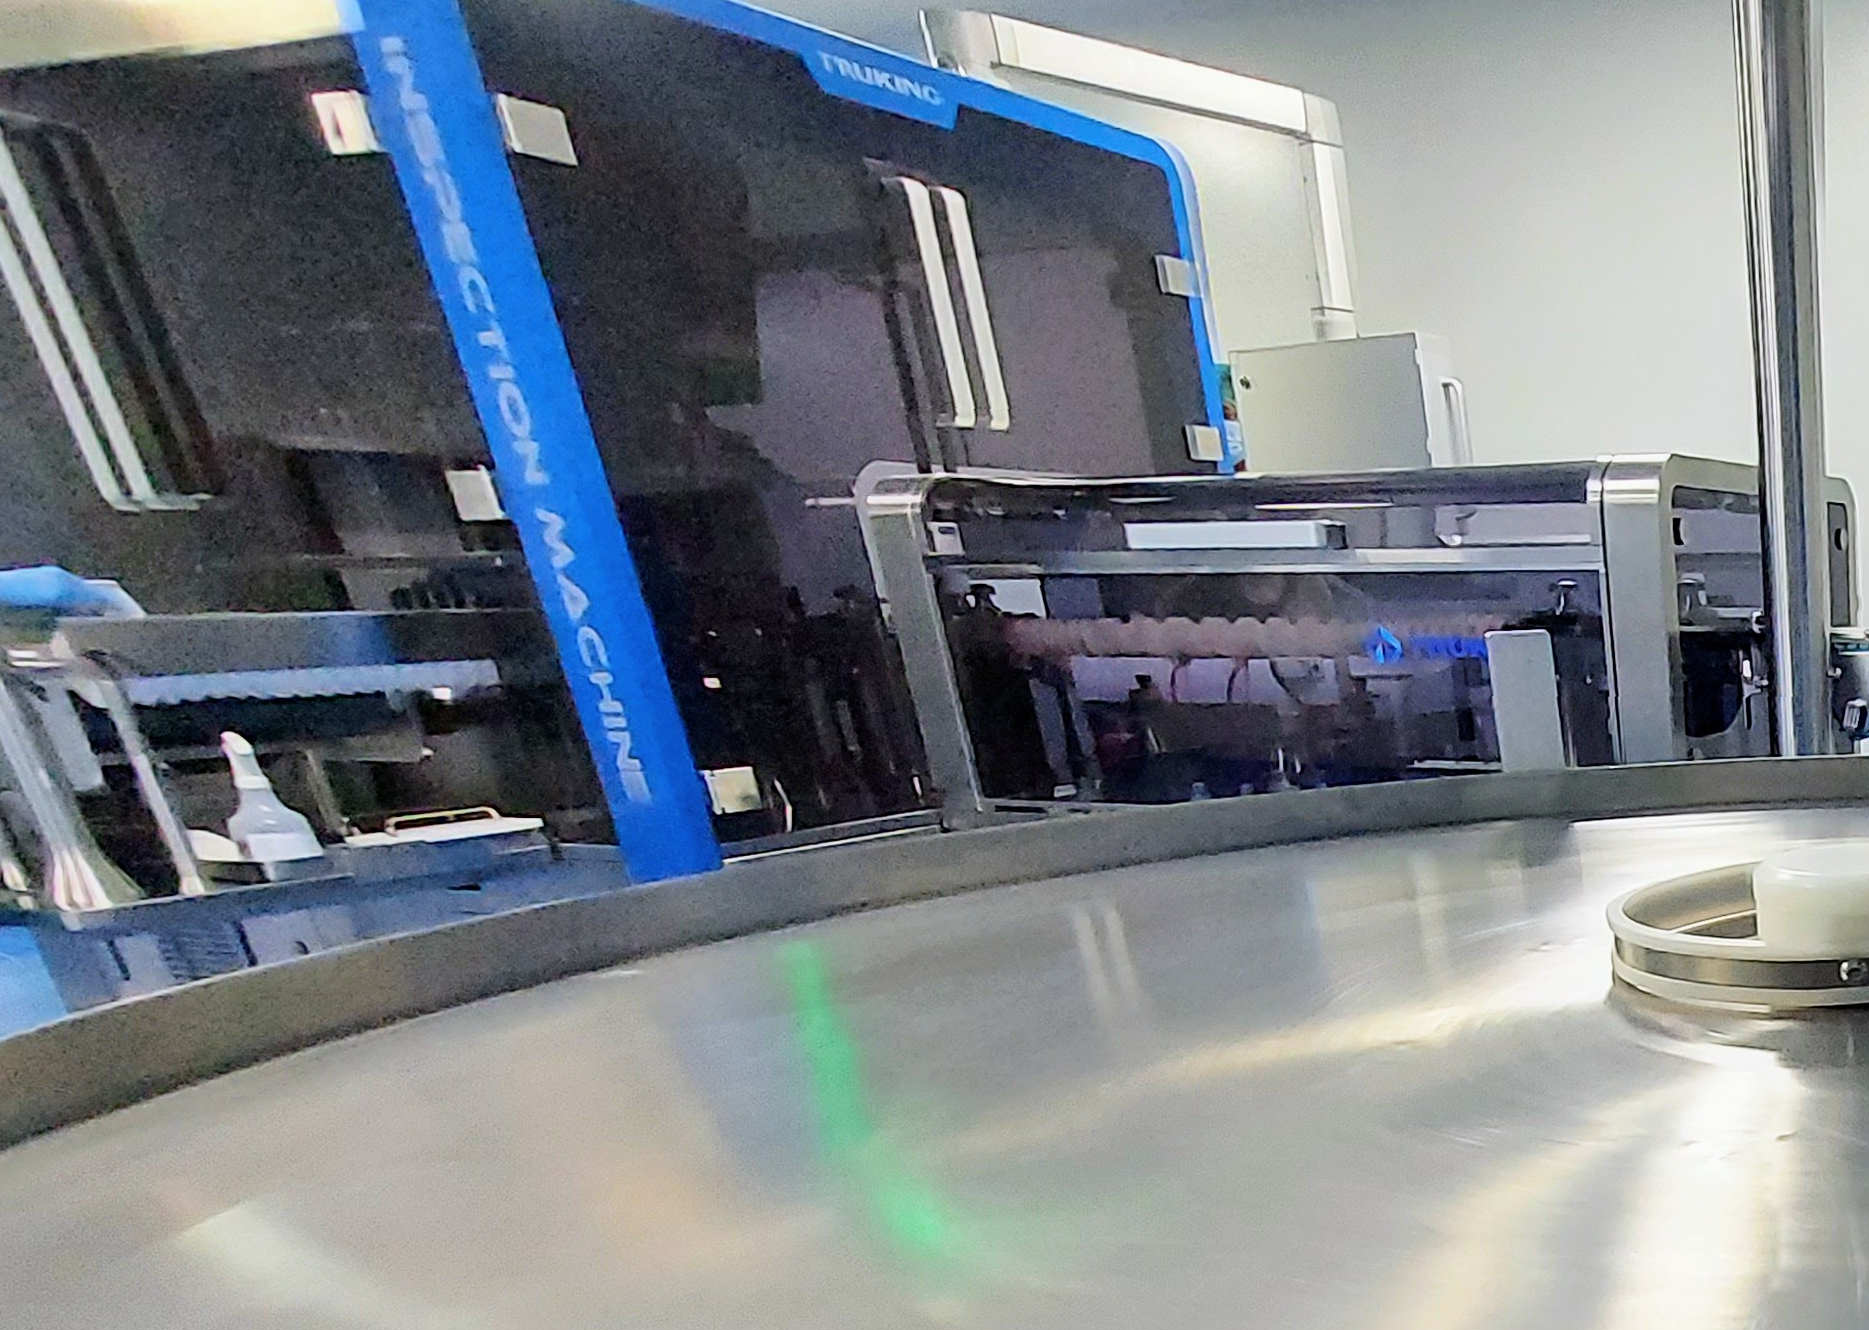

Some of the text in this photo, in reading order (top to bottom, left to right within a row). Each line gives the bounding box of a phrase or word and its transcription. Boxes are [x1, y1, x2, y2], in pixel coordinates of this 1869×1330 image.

[816, 50, 946, 107] TRUKING
[379, 35, 652, 803] INSPECTION MACHINE
